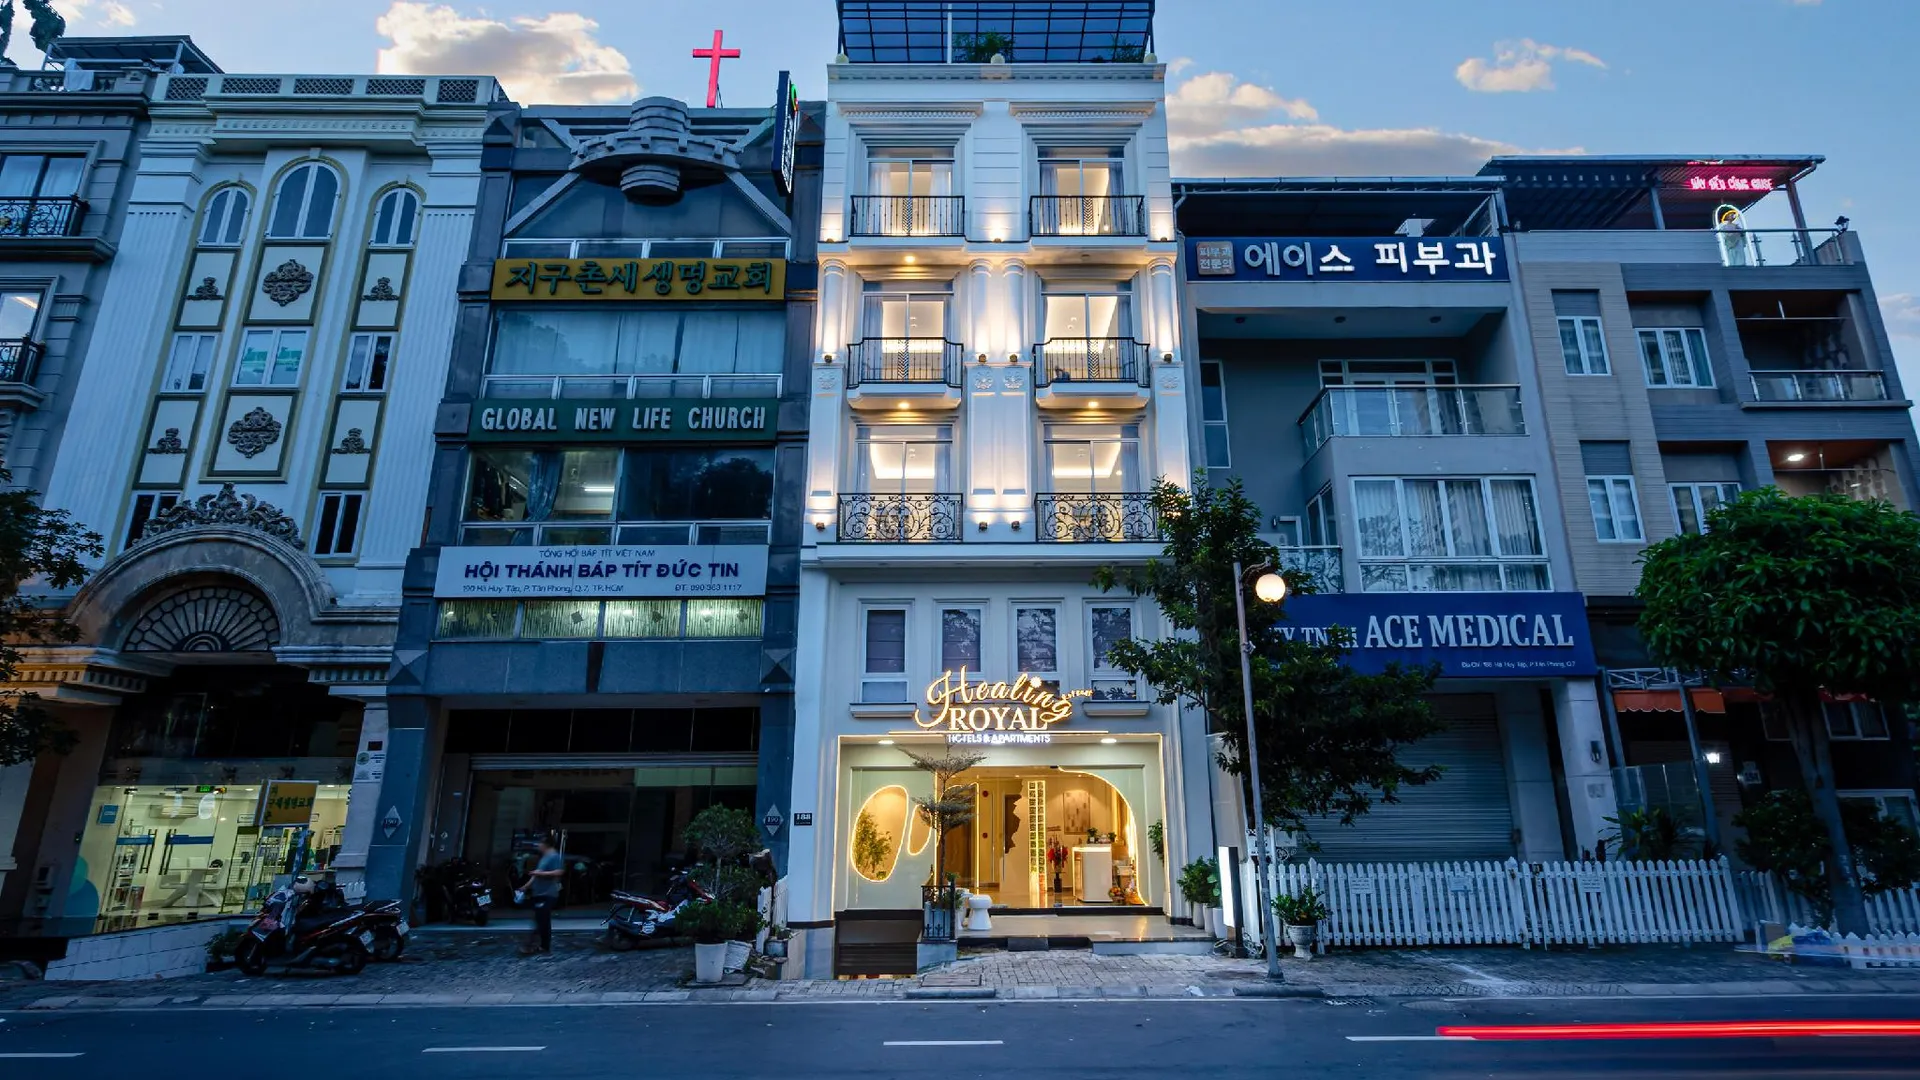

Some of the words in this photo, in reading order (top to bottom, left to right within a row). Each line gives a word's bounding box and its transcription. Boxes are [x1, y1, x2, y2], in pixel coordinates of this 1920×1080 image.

[1244, 241, 1355, 276] 에이스
[1374, 241, 1496, 275] 피부과
[481, 407, 557, 431] GLOBAL
[574, 407, 616, 430] NEW
[632, 407, 671, 430] LIFE
[687, 406, 766, 430] CHURCH
[464, 560, 500, 583] HỘI
[505, 560, 573, 579] THÁNH
[577, 560, 617, 578] BÁP
[622, 560, 652, 578] TÍT
[656, 559, 702, 578] ĐỨC
[708, 562, 739, 578] TIN
[1364, 614, 1423, 649] ACE
[1427, 613, 1575, 648] MEDICAL
[915, 665, 1072, 727] Healing
[949, 706, 1048, 732] ROYAL
[948, 733, 982, 744] HOTELS
[983, 733, 991, 744] &
[990, 734, 1051, 745] APARTMENTS
